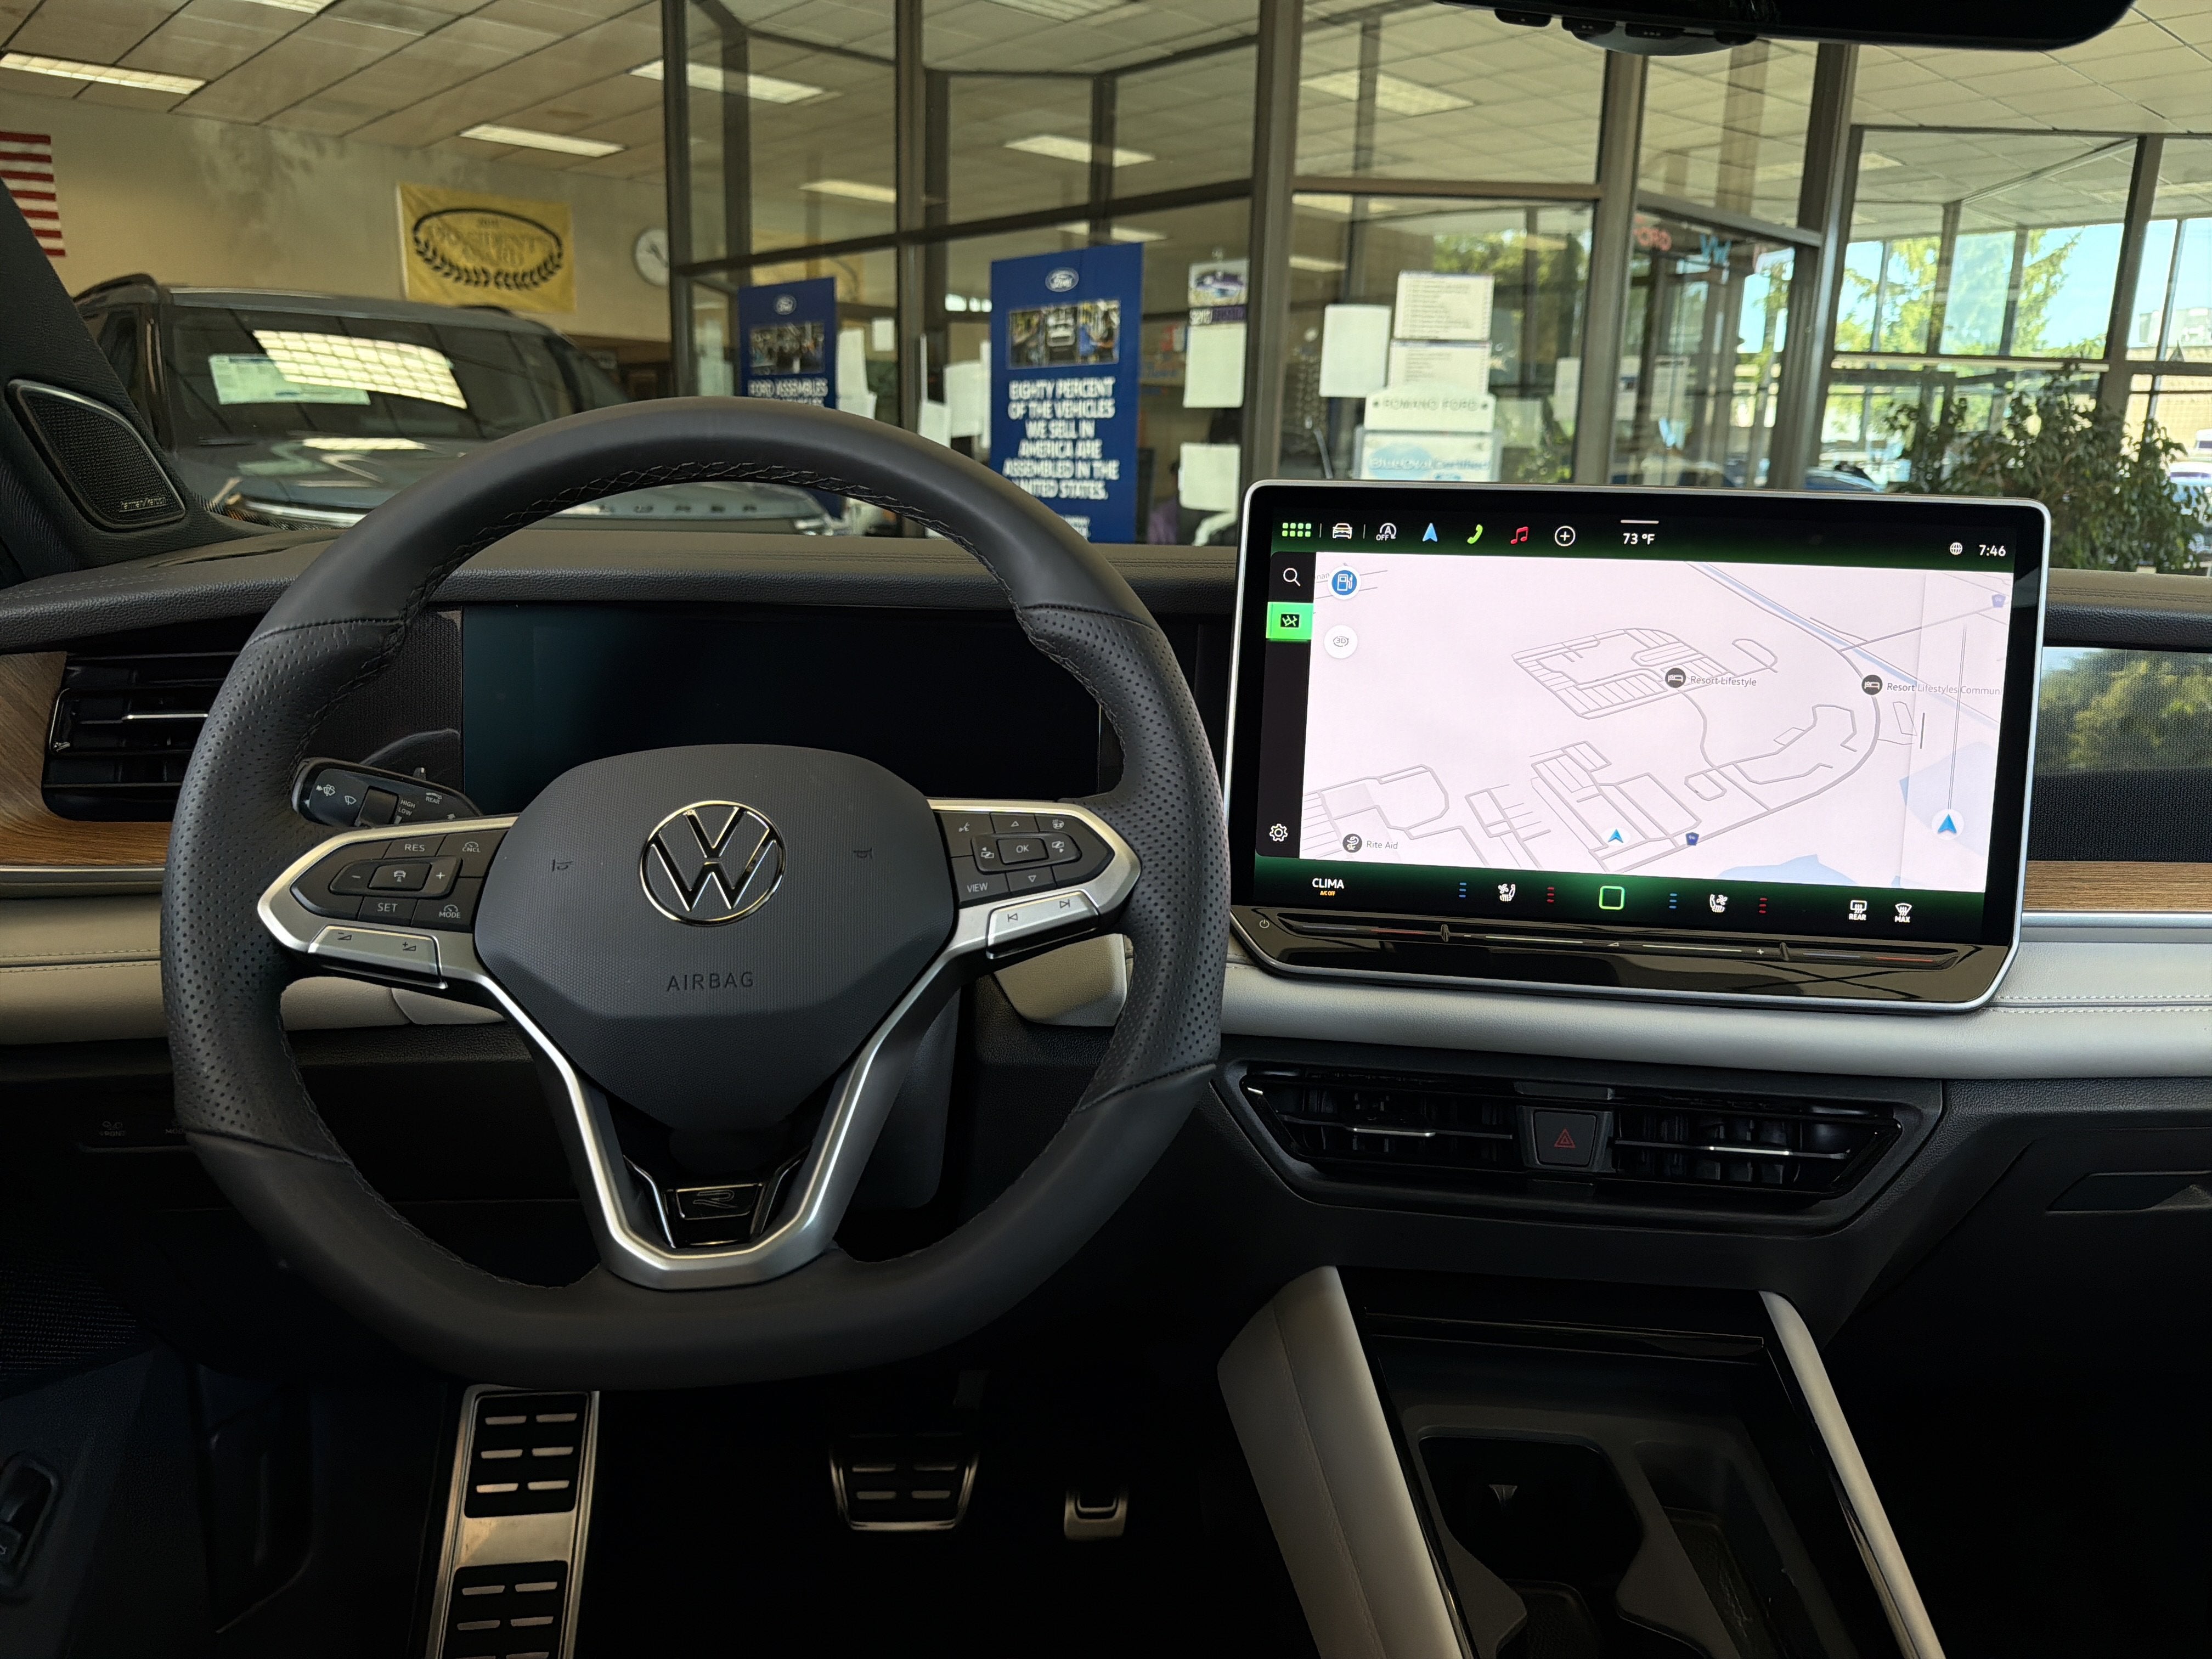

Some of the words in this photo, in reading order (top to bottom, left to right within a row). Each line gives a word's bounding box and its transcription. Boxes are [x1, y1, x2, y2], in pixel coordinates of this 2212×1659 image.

[1009, 379, 1054, 400] EIGHTY
[1056, 376, 1115, 399] PERCENT
[1008, 400, 1027, 420] OF
[1028, 399, 1053, 420] THE
[1054, 397, 1115, 419] VEHICLES
[1025, 419, 1047, 439] WE
[1048, 419, 1078, 438] SELL
[1079, 419, 1095, 438] IN
[1018, 438, 1073, 459] AMERICA
[1074, 438, 1103, 459] ARE
[1002, 457, 1074, 478] ASSEMBLED
[1075, 459, 1091, 479] IN
[1092, 459, 1120, 481] THE
[1623, 533, 1639, 545] 73
[1979, 544, 2006, 557] 7:46
[1690, 675, 1718, 685] Resort
[1720, 676, 1757, 687] Lifestyle
[1887, 682, 1915, 692] Resort
[1917, 684, 1958, 695] Lifestyles
[400, 799, 416, 809] HIGH
[425, 796, 440, 805] REAR
[398, 807, 413, 816] LOW
[404, 843, 425, 852] RES
[1016, 844, 1029, 854] OK
[1367, 840, 1383, 849] Rite
[967, 882, 988, 893] VIEW
[1312, 878, 1345, 889] CLIMA
[377, 902, 398, 913] SET
[1848, 913, 1867, 921] REAR
[667, 971, 754, 992] AIRBAG
